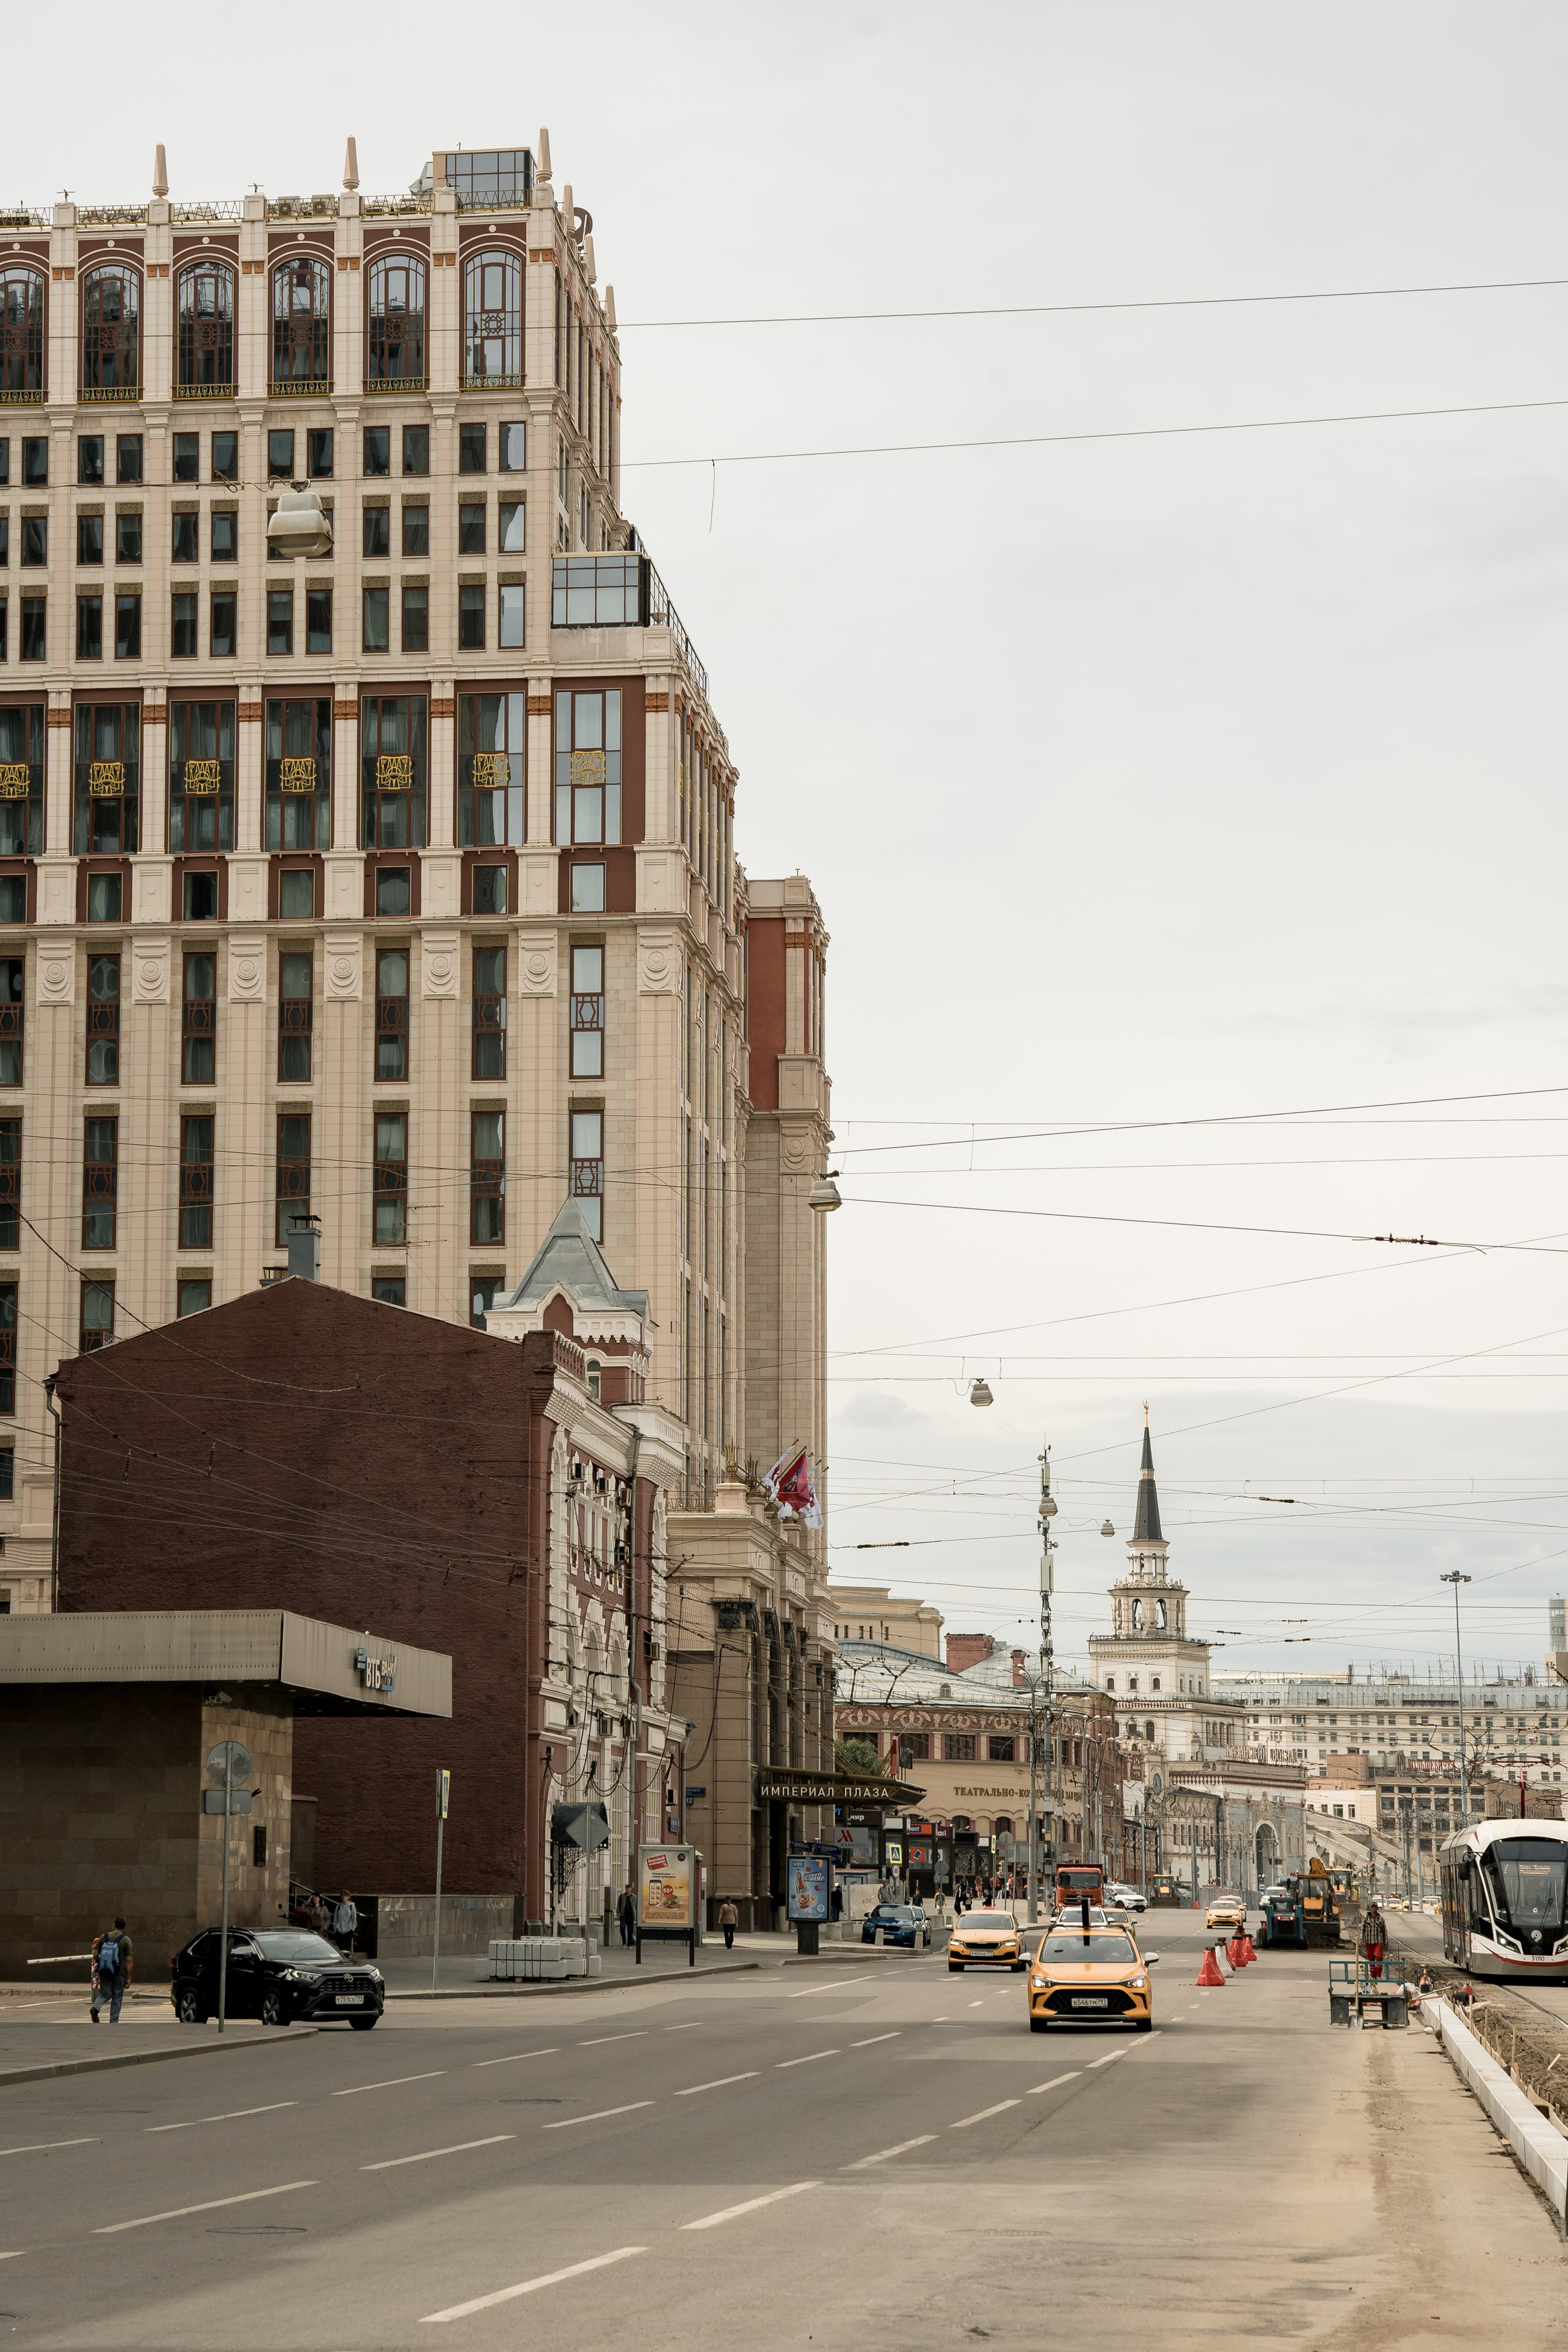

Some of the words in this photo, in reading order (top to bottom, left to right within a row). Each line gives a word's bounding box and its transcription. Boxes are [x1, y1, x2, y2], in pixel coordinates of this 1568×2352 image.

[366, 1656, 380, 1689] ВТБ
[381, 1660, 394, 1678] БАНК
[1225, 1744, 1267, 1760] КАЗАНСКИЙ
[1272, 1749, 1297, 1763] ВОКЗАЛ
[761, 1787, 834, 1796] ИМПЕРИАЛ
[845, 1787, 889, 1798] ПЛАЗА
